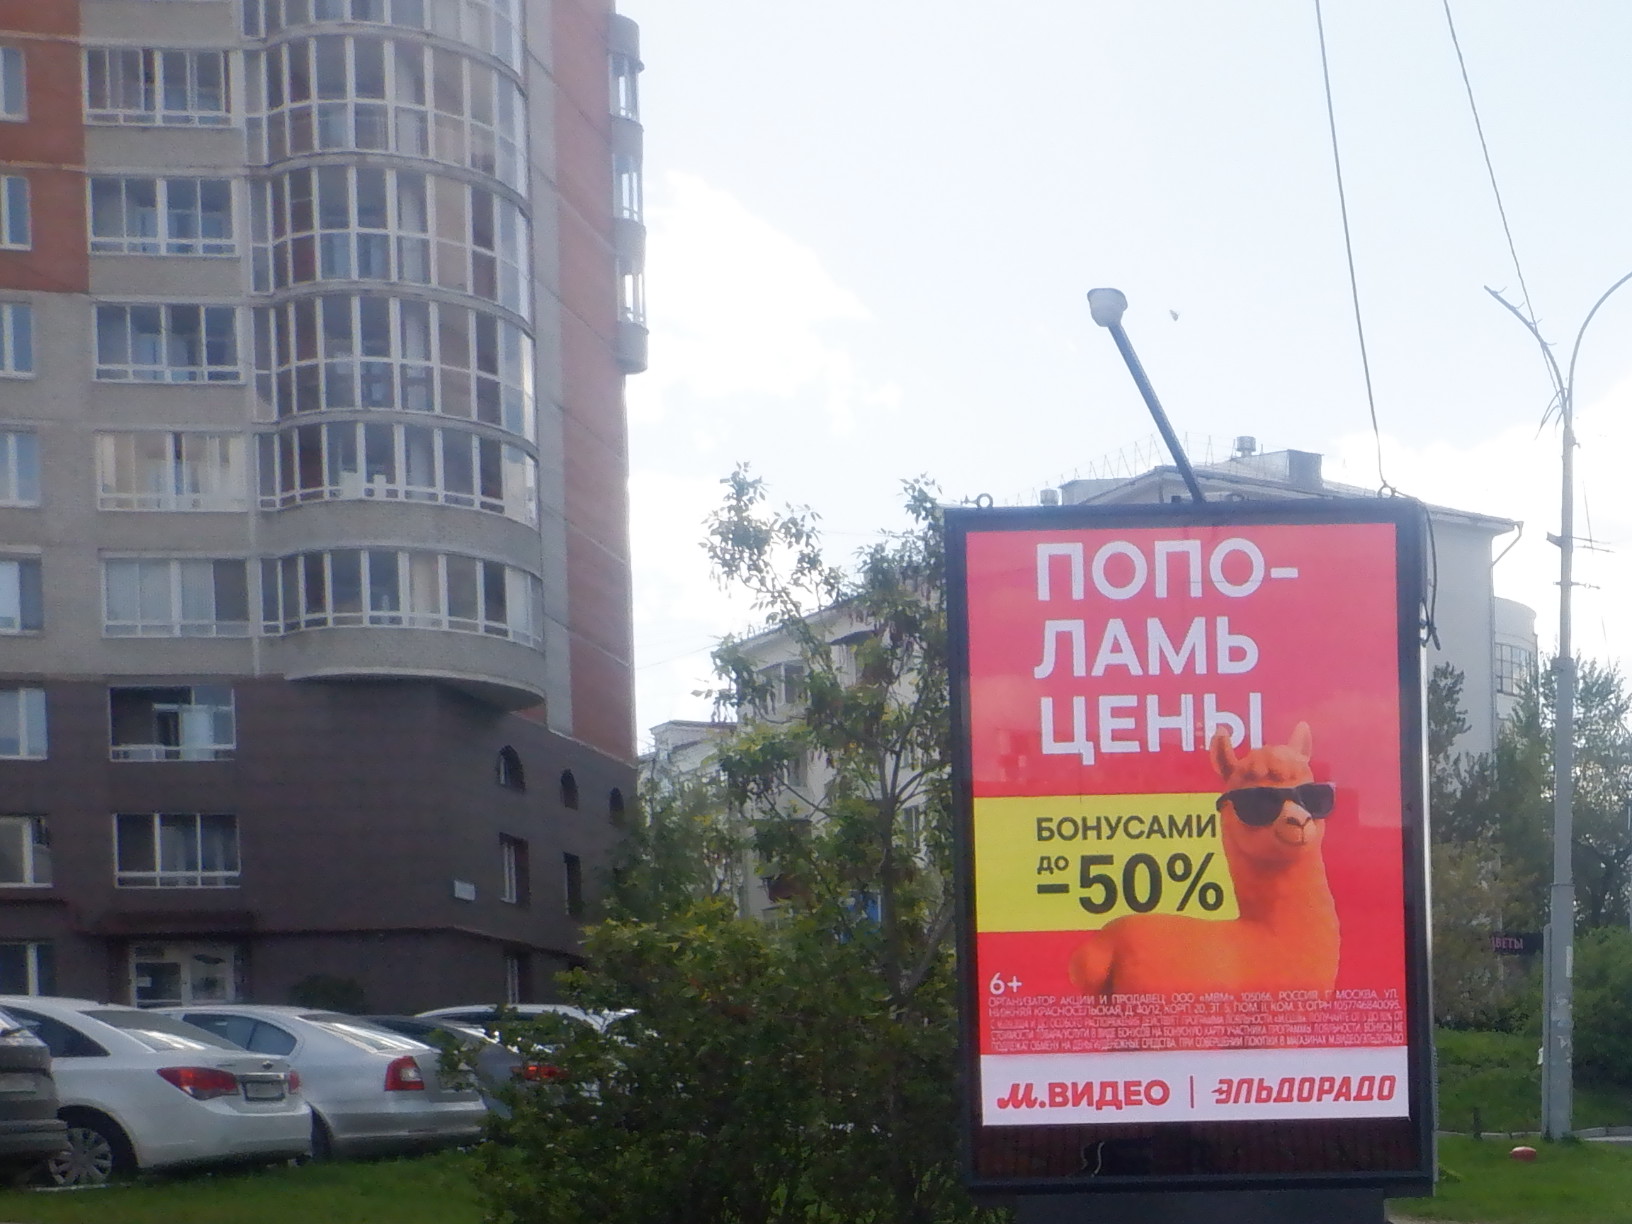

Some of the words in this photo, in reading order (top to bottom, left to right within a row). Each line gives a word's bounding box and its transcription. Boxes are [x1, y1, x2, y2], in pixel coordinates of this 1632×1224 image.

[1036, 538, 1299, 601] ПОПО-
[1034, 616, 1259, 679] ЛАМЬ
[1041, 692, 1263, 766] ЦЕНЫ
[1036, 814, 1217, 841] БОНУСАМИ
[989, 972, 1022, 995] 6+
[1060, 995, 1095, 1005] АКЦИИ
[1099, 995, 1107, 1005] И
[1171, 993, 1195, 1003] ООО
[1384, 989, 1398, 998] УЛ.
[1212, 1075, 1396, 1105] ЭЛЬДОРАДО
